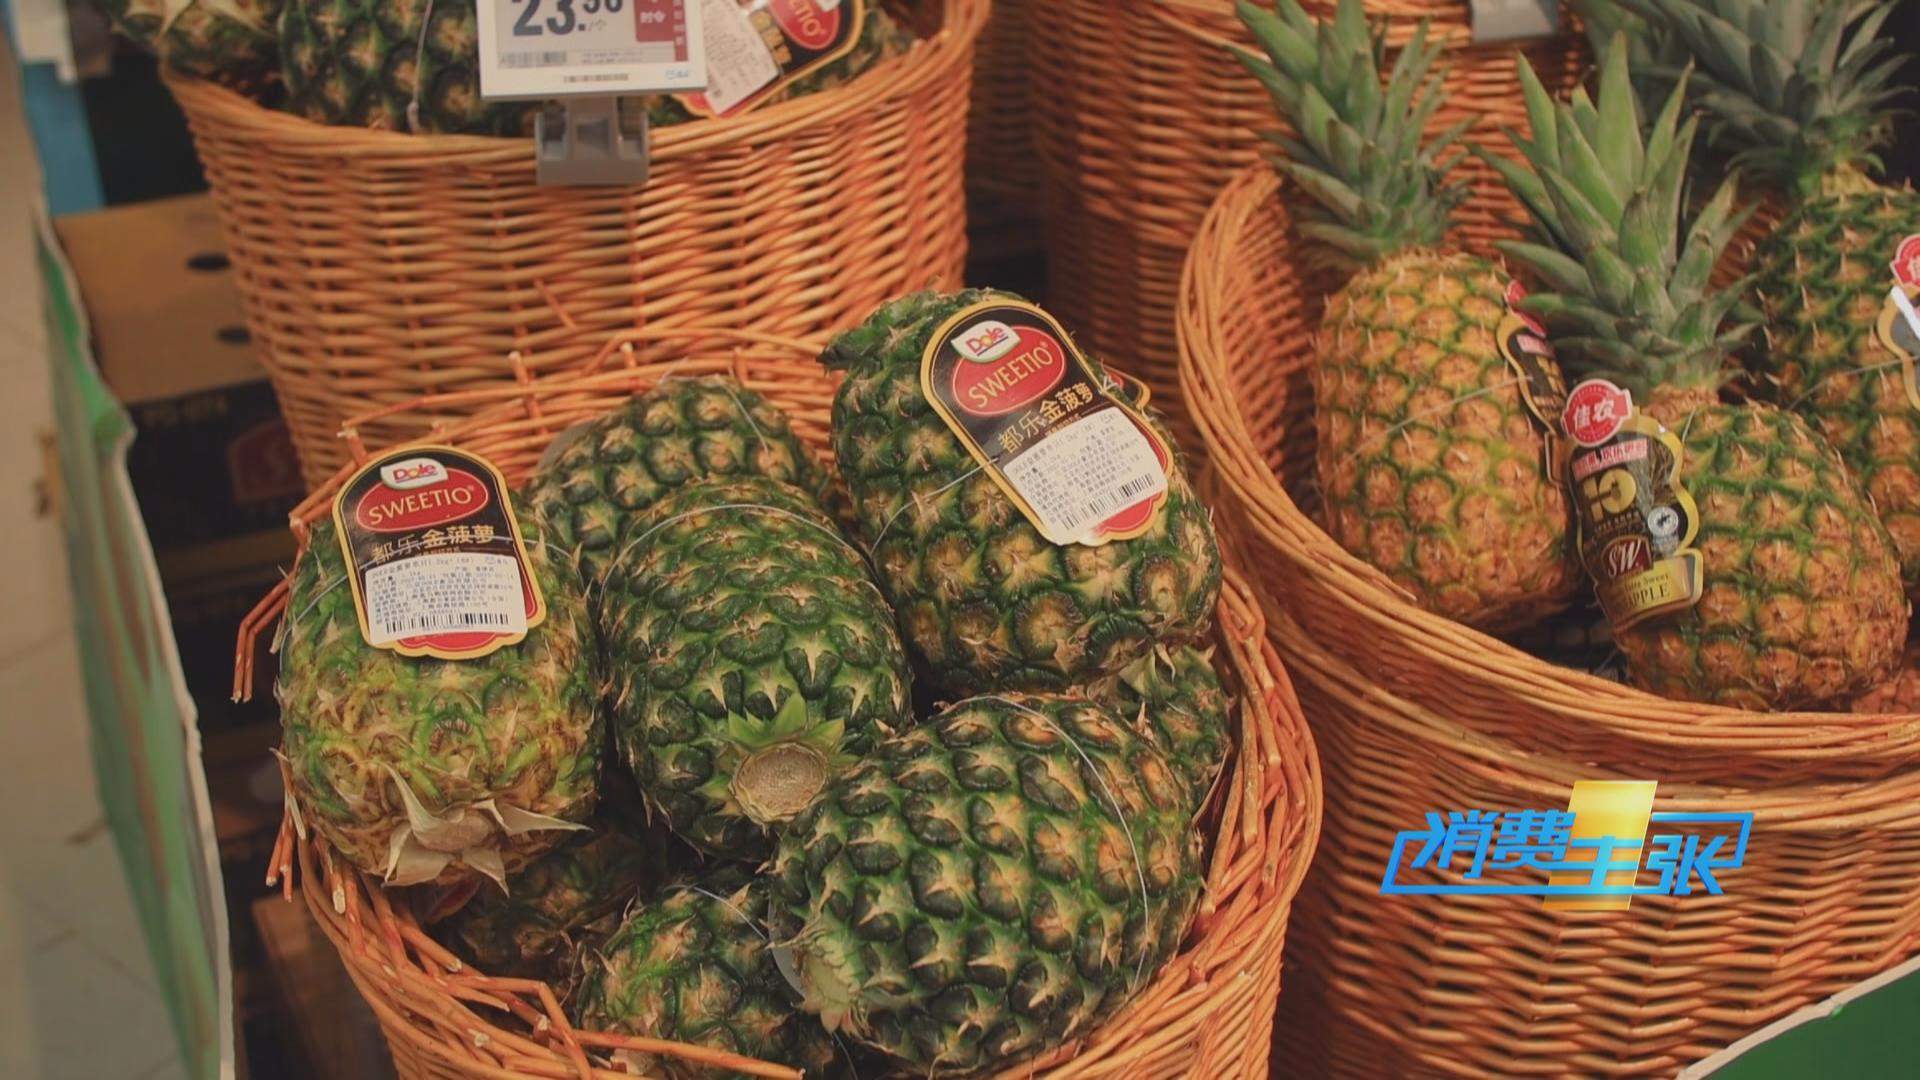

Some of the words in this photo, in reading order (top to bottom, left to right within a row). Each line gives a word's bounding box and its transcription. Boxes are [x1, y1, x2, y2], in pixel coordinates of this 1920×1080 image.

[966, 327, 1009, 354] Dole
[968, 345, 1053, 409] SWEETIO
[998, 382, 1094, 453] 都乐金菠萝
[1573, 397, 1617, 431] 佳农
[393, 463, 437, 483] Dole
[368, 487, 472, 525] SWEETIO
[372, 524, 495, 565] 都乐金菠萝
